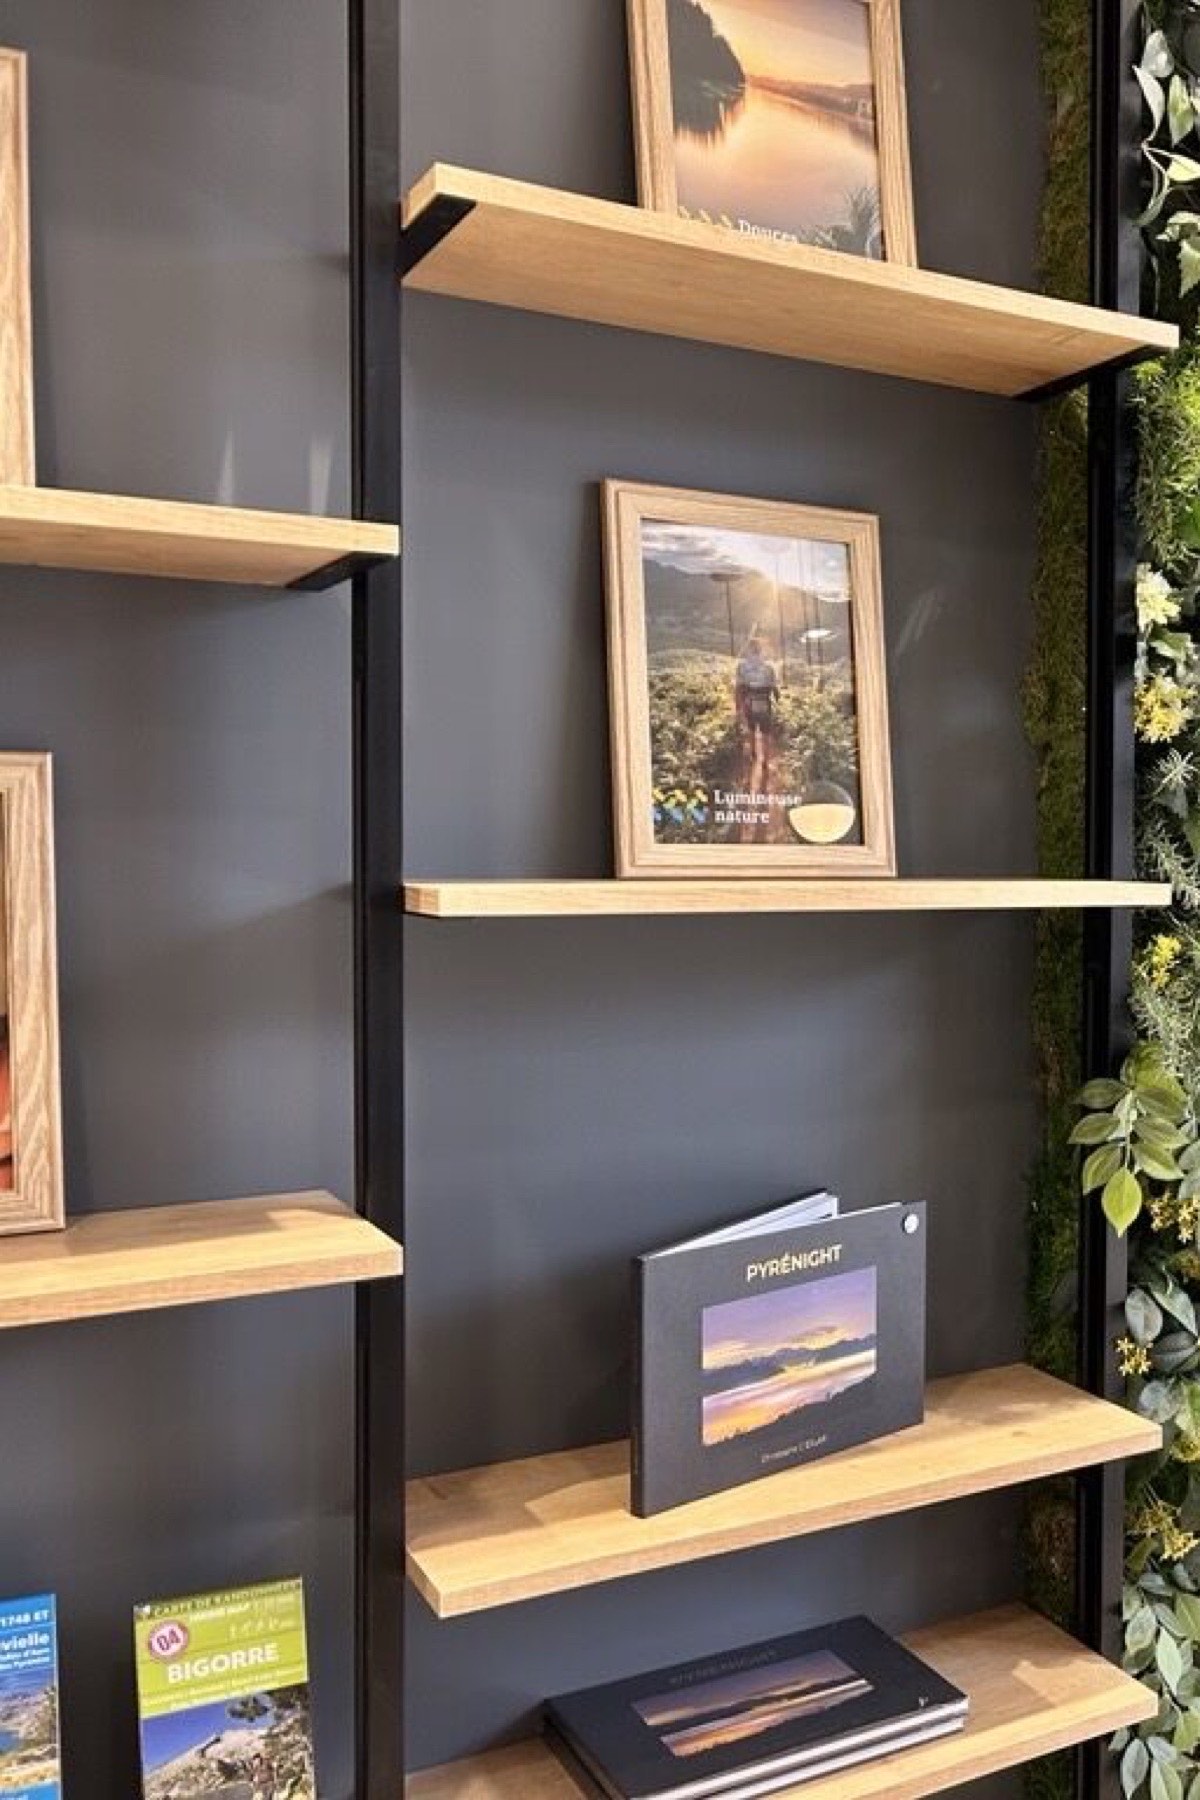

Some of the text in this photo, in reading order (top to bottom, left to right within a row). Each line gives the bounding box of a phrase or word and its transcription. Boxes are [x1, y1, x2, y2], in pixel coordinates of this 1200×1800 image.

[713, 788, 802, 808] Lumineuse
[714, 810, 770, 824] nature
[746, 1243, 843, 1283] PYRÉNIGHT
[33, 1609, 48, 1621] ET
[156, 1628, 181, 1651] 04
[167, 1642, 280, 1685] BIGORRE
